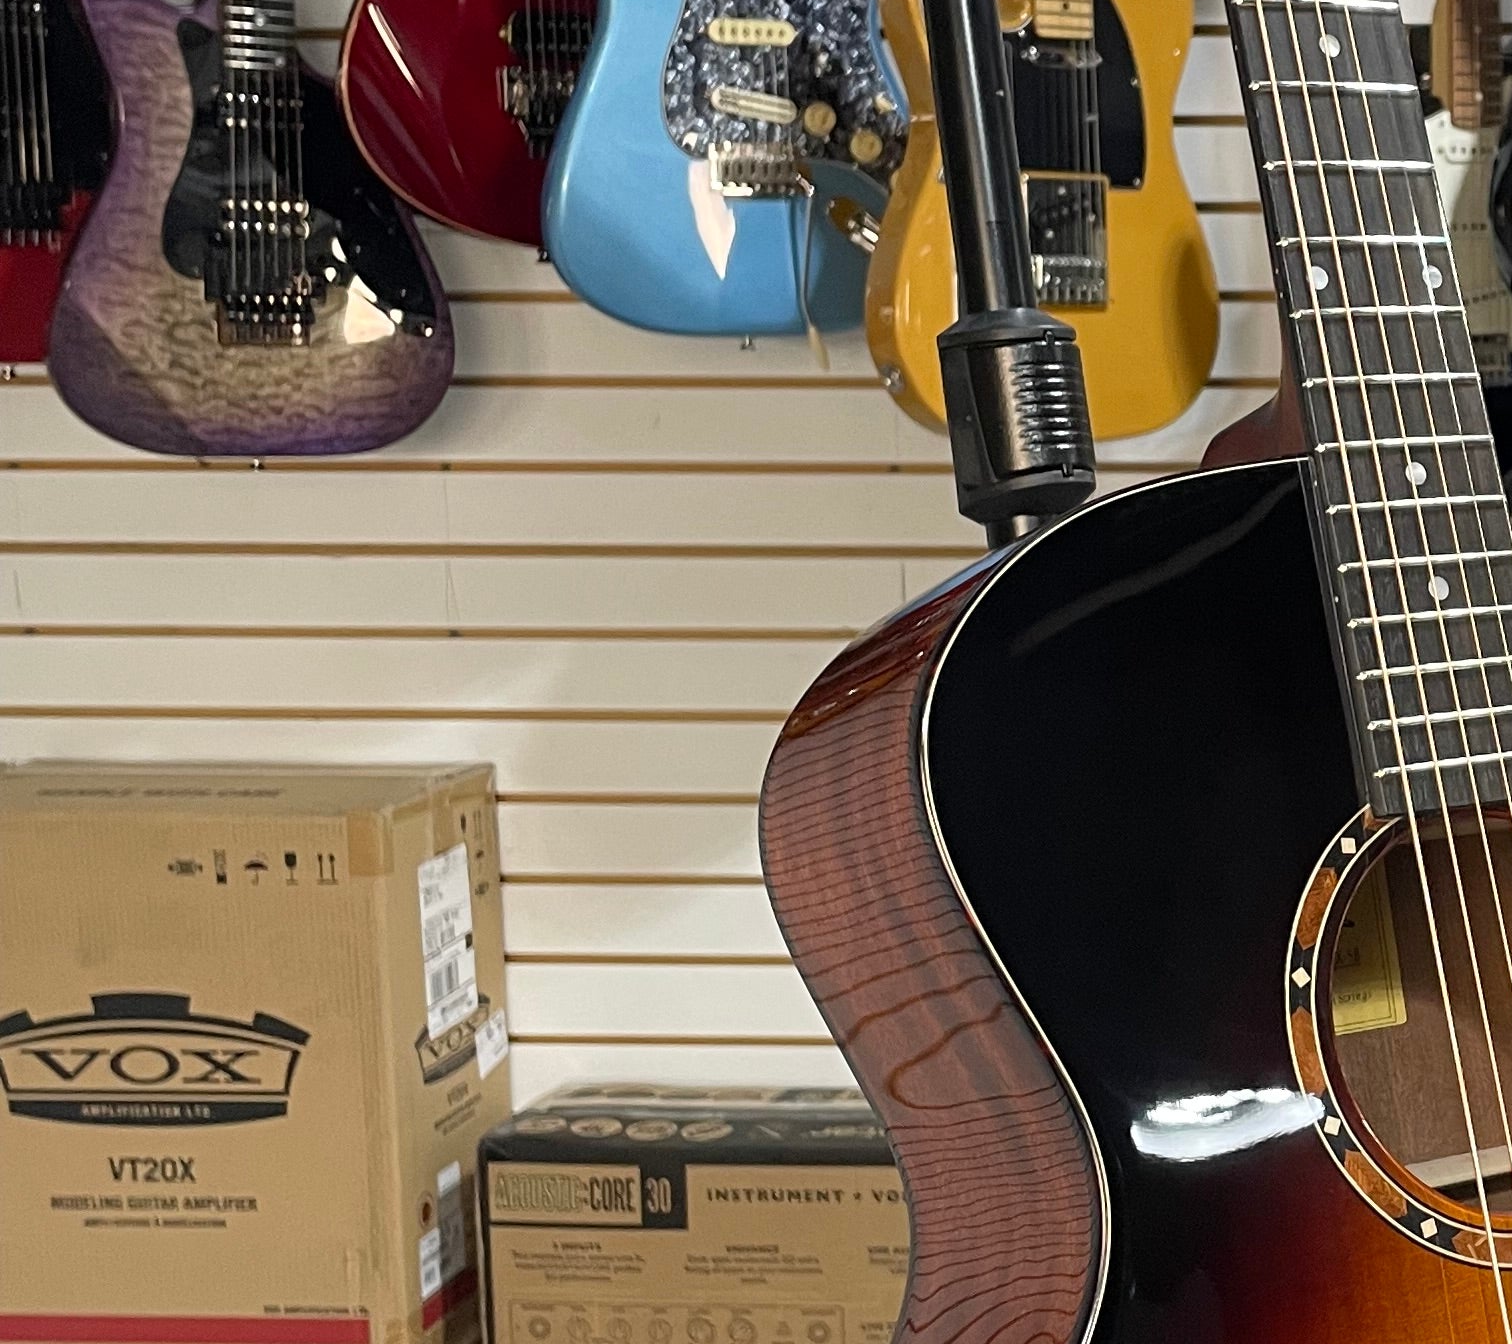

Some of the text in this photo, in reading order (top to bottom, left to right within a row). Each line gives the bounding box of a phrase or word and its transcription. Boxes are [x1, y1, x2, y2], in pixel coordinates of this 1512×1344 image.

[20, 1045, 262, 1085] VOX
[108, 1156, 197, 1183] VT20X
[51, 1196, 257, 1212] MODELING GUITAR AMPLIFIER
[646, 1176, 672, 1214] 30
[707, 1187, 845, 1205] INSTRUMENT
